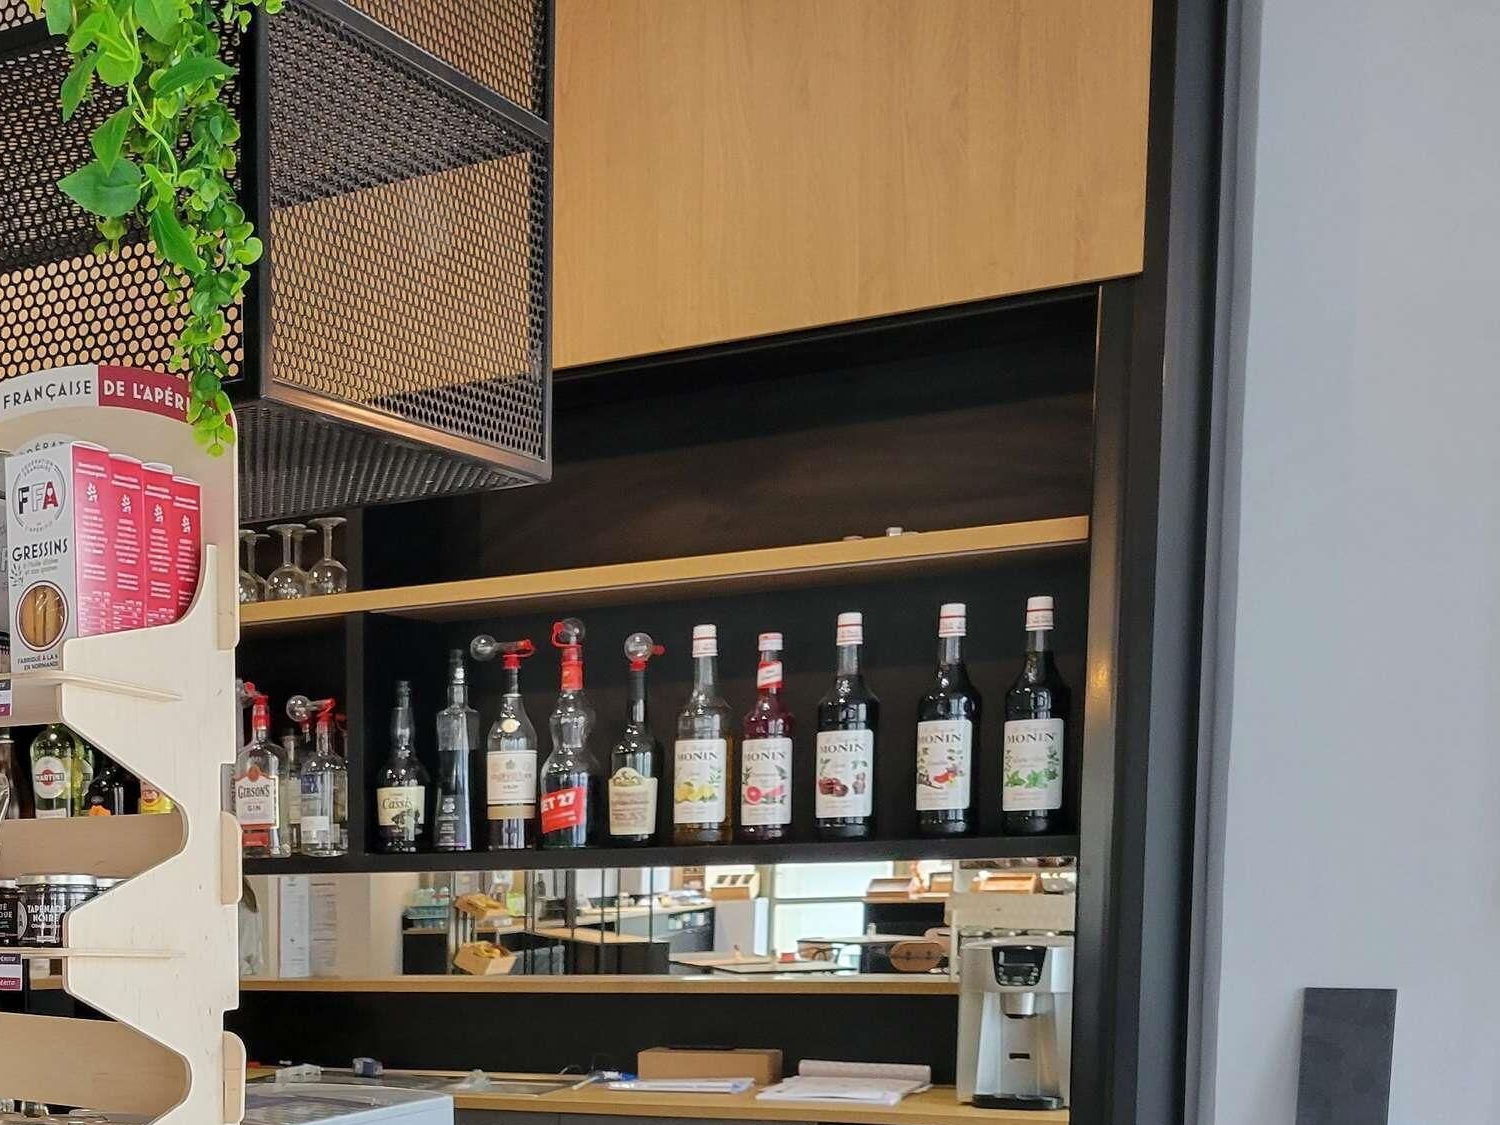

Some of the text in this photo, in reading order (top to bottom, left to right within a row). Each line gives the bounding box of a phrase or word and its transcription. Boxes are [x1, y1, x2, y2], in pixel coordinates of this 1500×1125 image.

[3, 383, 92, 410] FRANÇAISE
[104, 379, 125, 398] DE
[132, 383, 191, 411] L'APÉRI
[12, 538, 68, 561] GRESSINS
[920, 734, 962, 743] MONIN
[1006, 733, 1055, 743] MONIN
[820, 744, 864, 753] MONIN
[237, 784, 271, 799] GIBSON'S
[382, 797, 413, 810] Cassis
[541, 792, 576, 813] ET 27
[246, 804, 261, 812] GIN
[27, 904, 67, 914] TAPENADE
[32, 913, 60, 923] NOIRE
